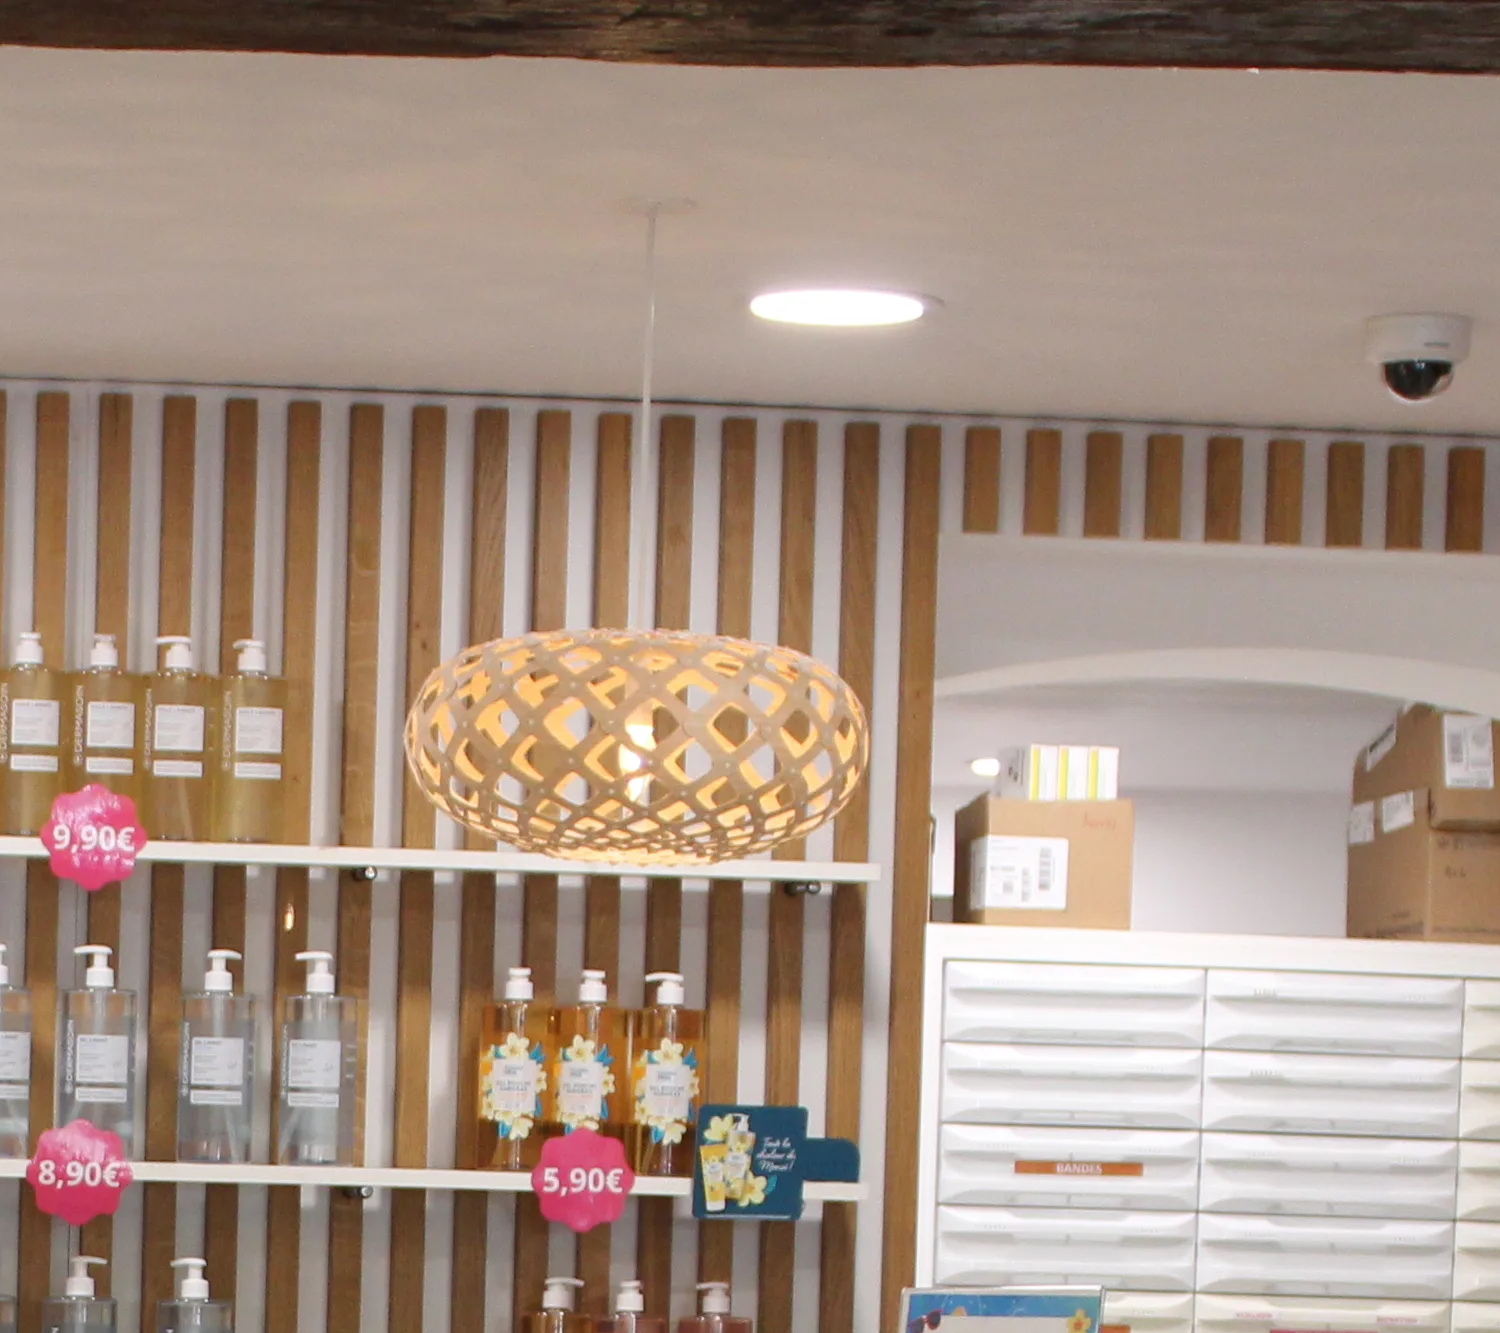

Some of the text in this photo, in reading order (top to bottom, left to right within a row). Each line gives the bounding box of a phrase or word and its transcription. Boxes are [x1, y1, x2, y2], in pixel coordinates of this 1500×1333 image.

[52, 825, 135, 853] 9,90€
[37, 1161, 121, 1189] 8,90€
[1056, 1162, 1102, 1174] BANDES
[543, 1168, 623, 1197] 5,90€
